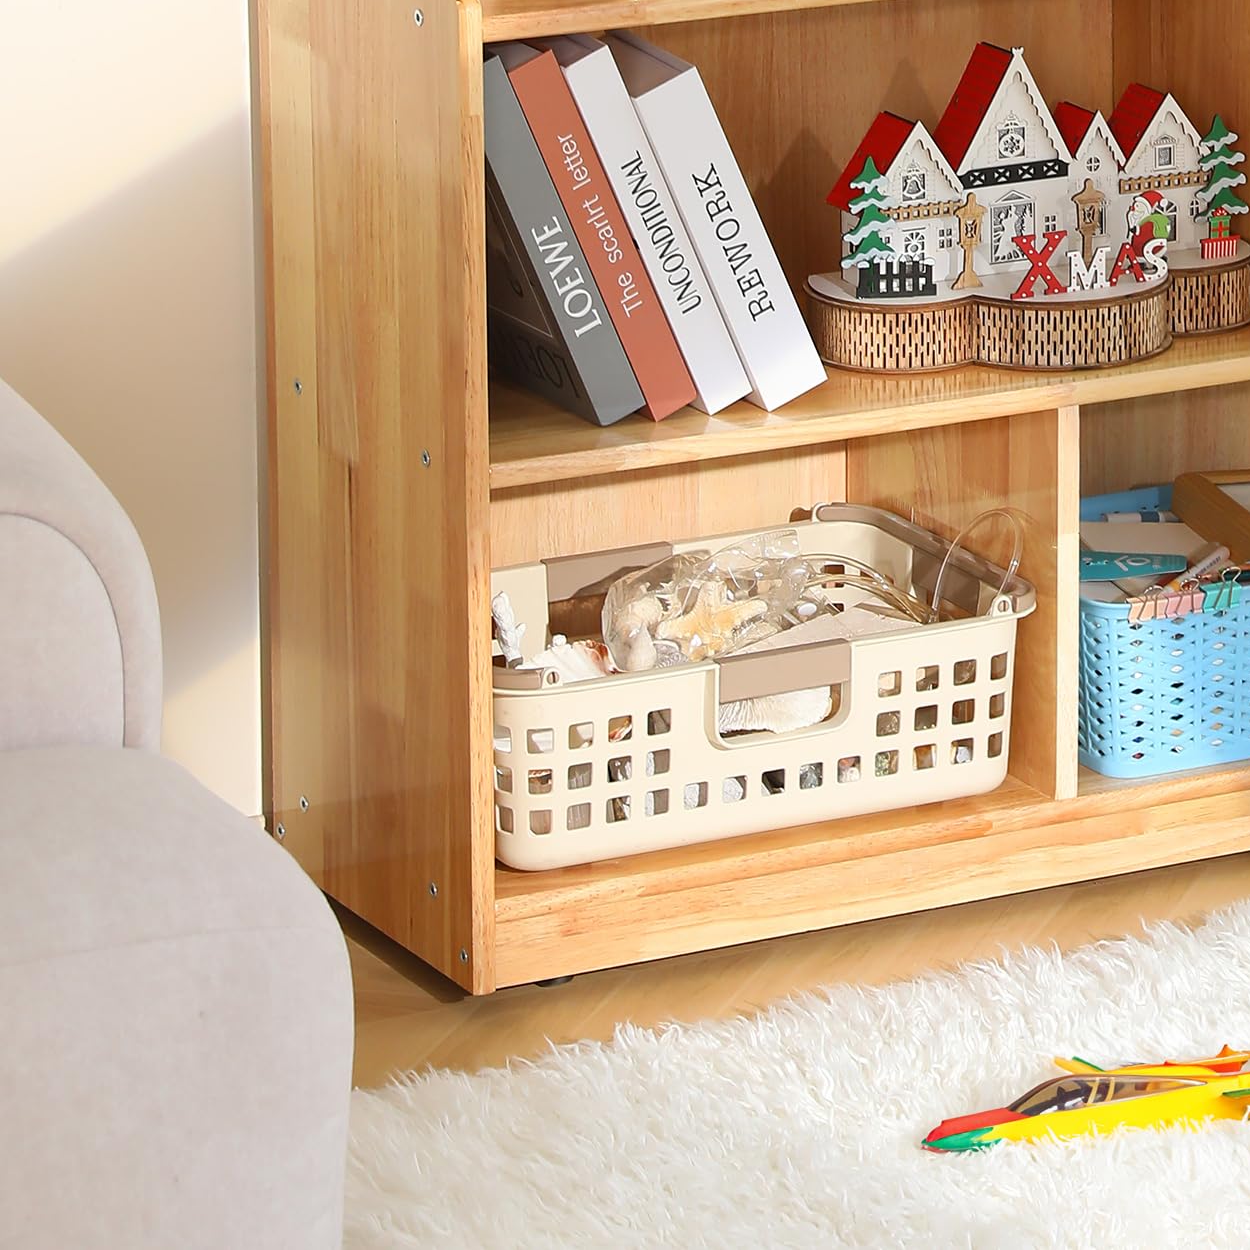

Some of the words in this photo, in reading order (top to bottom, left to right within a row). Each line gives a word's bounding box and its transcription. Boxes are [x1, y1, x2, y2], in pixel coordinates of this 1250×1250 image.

[557, 133, 592, 191] letter
[582, 194, 623, 264] scarlrt
[620, 149, 702, 315] UNCONDITIONAL
[691, 162, 776, 323] REWORK
[1009, 229, 1169, 301] XMAS
[531, 215, 602, 338] LOEWE
[618, 271, 643, 318] The
